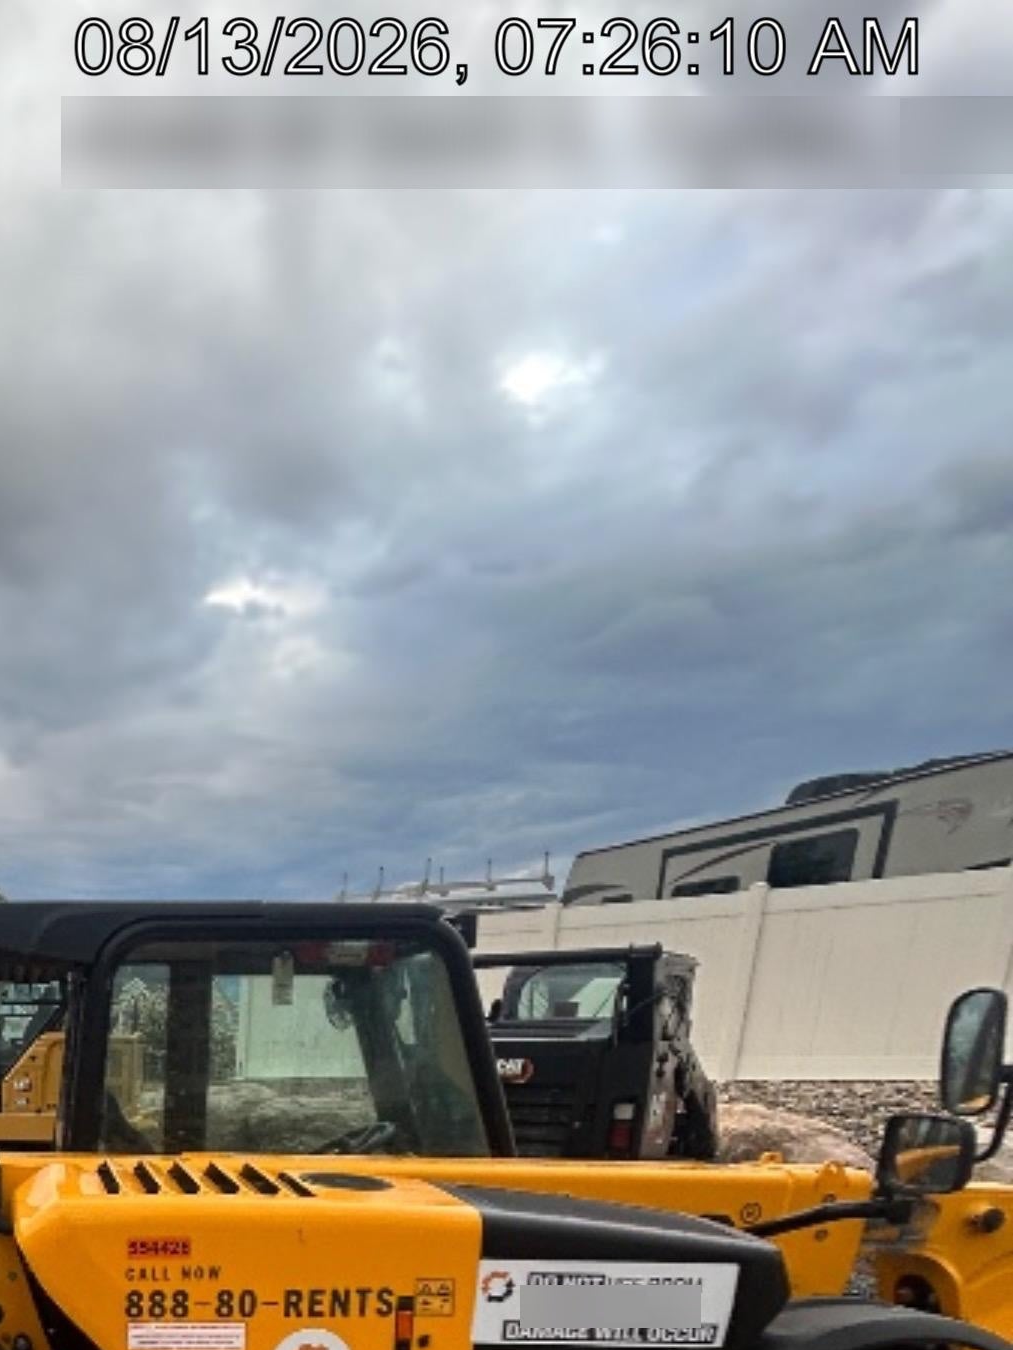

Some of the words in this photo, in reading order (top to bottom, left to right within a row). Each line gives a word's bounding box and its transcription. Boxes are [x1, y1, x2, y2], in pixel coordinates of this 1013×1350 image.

[497, 1058, 525, 1076] CAT
[125, 1267, 171, 1281] CALL
[182, 1265, 222, 1280] NOW
[124, 1288, 394, 1319] 888-80-RENTS
